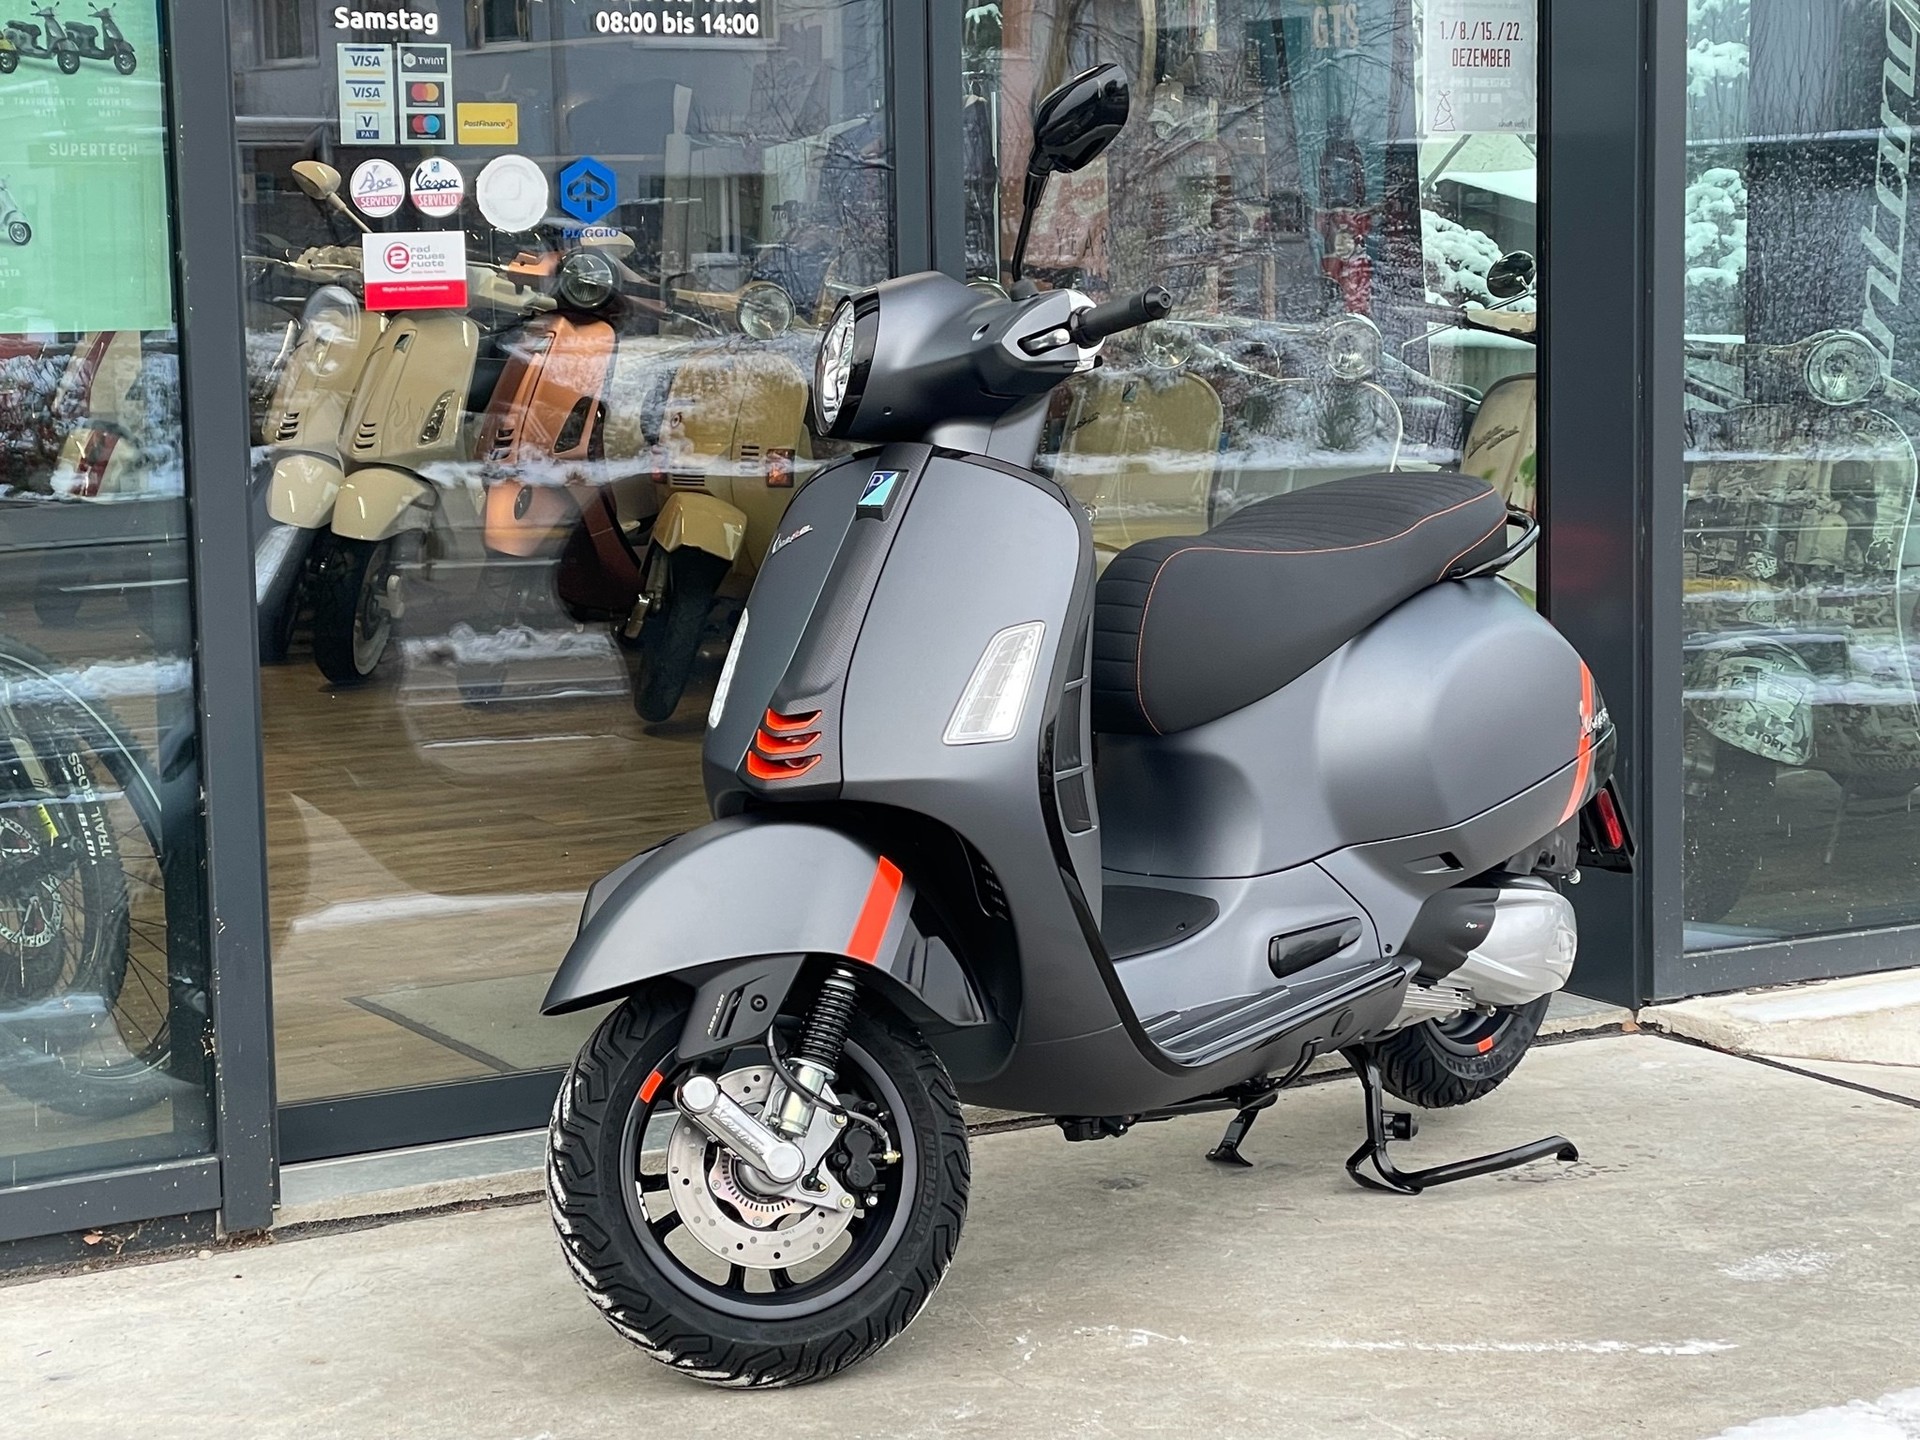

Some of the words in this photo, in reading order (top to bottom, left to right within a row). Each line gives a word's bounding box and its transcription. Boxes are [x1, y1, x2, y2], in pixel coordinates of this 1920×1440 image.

[334, 6, 438, 35] Samstag
[596, 11, 657, 34] 08:00
[662, 11, 695, 34] bis
[701, 13, 759, 35] 14:00
[1312, 4, 1359, 49] GTS
[1440, 21, 1523, 41] 1./8./15./22.
[351, 55, 381, 67] VISA
[418, 56, 445, 66] TWINT
[1452, 48, 1511, 68] DEZEMBER
[352, 87, 381, 98] VISA
[361, 115, 373, 128] V
[464, 119, 506, 129] PostFinance
[48, 143, 138, 157] SUPERTECH
[358, 171, 398, 195] Ape
[414, 167, 460, 192] Vespa
[360, 196, 397, 208] SERVIZIO
[417, 193, 457, 206] SERVIZIO
[560, 227, 619, 239] PIAGGIO
[410, 245, 431, 253] rad
[410, 260, 445, 268] ruote
[67, 751, 97, 803] BOSS
[90, 805, 113, 857] TRAIL
[913, 1132, 938, 1239] MICHELIN
